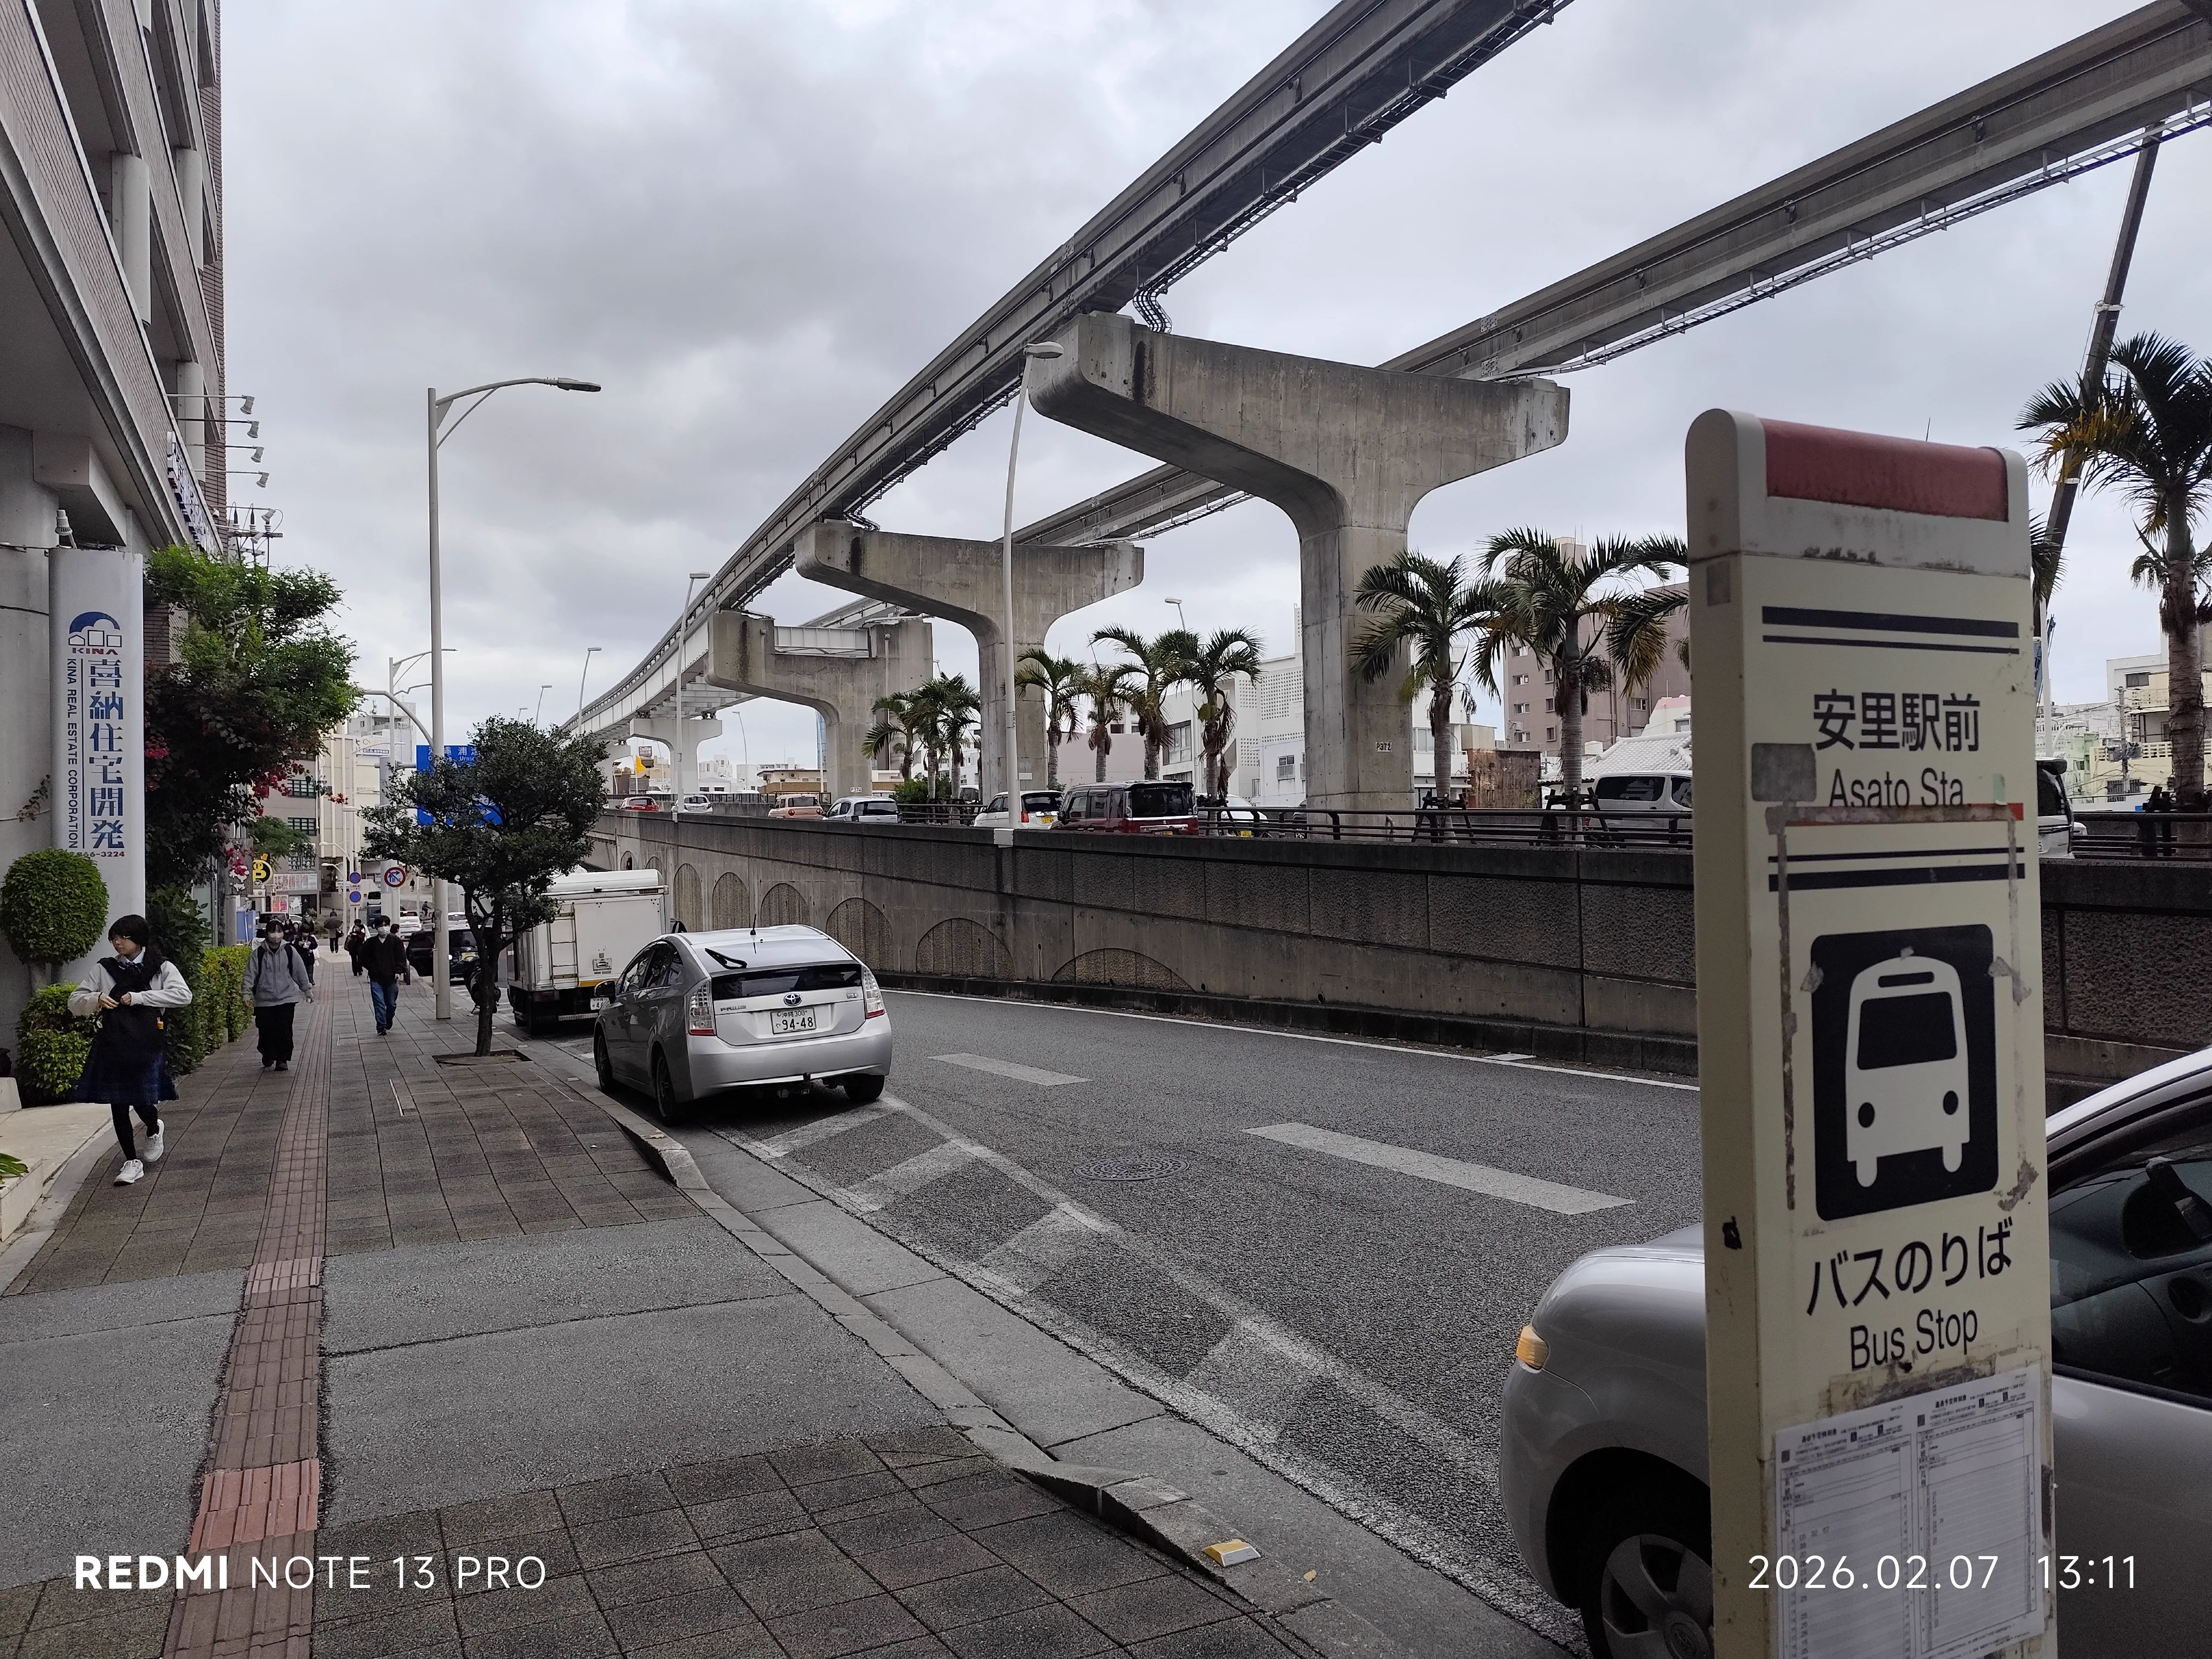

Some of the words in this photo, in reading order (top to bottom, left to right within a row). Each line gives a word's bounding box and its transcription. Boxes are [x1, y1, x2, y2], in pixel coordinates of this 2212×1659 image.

[67, 658, 77, 684] KINA
[67, 689, 77, 718] REAL
[1813, 689, 1980, 751] 安里駅前
[68, 723, 78, 765] ESTATE
[88, 659, 125, 848] 喜納住宅開発
[68, 769, 78, 848] CORPORATION
[1829, 769, 1909, 807] Asato
[1921, 768, 1963, 807] Sta
[782, 1017, 813, 1030] 94-48
[1806, 1216, 2014, 1316] バスのりば
[1850, 1325, 1905, 1371] Bus
[1917, 1309, 1978, 1355] Stop
